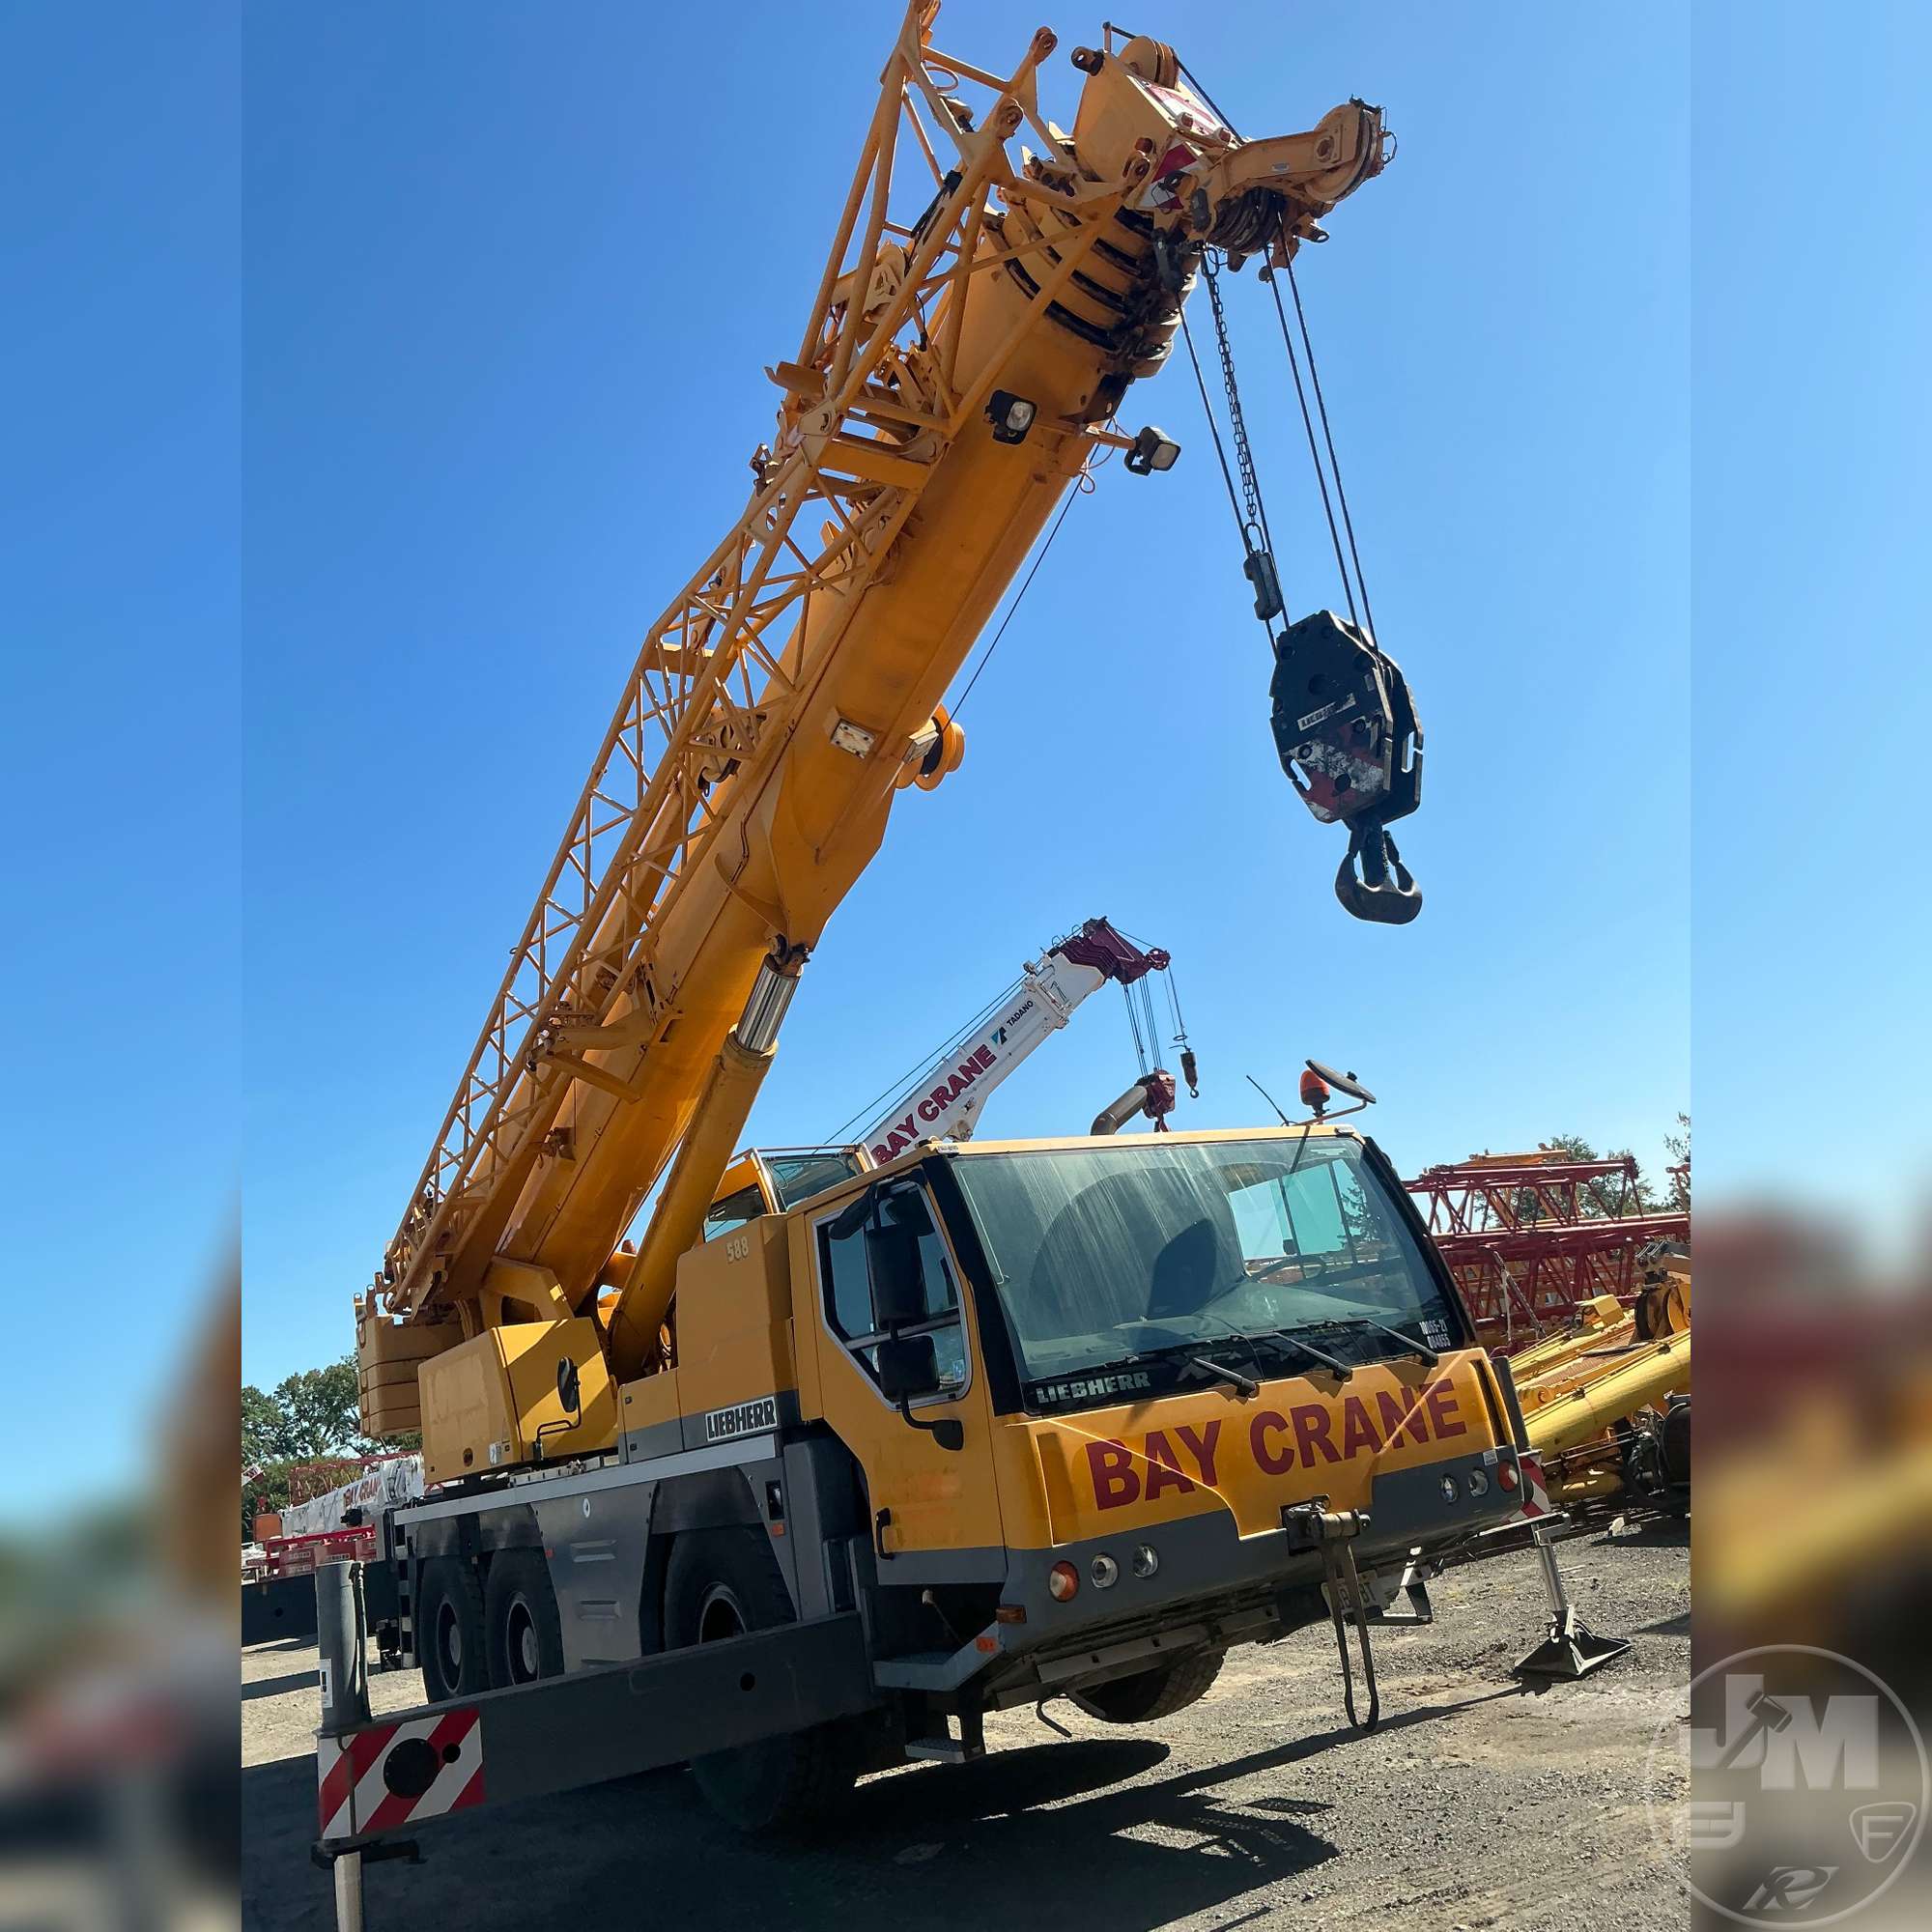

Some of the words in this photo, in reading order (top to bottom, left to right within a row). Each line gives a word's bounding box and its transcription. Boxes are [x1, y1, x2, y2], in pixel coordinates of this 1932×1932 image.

[1006, 1000, 1034, 1027] TADANO
[870, 1113, 920, 1165] BAY
[917, 1043, 998, 1122] CRANE
[726, 1236, 749, 1263] 588
[1036, 1372, 1151, 1405] LIEBHERR
[707, 1399, 776, 1439] LIEBHERR
[1085, 1419, 1222, 1511] BAY
[1249, 1378, 1467, 1475] CRANE
